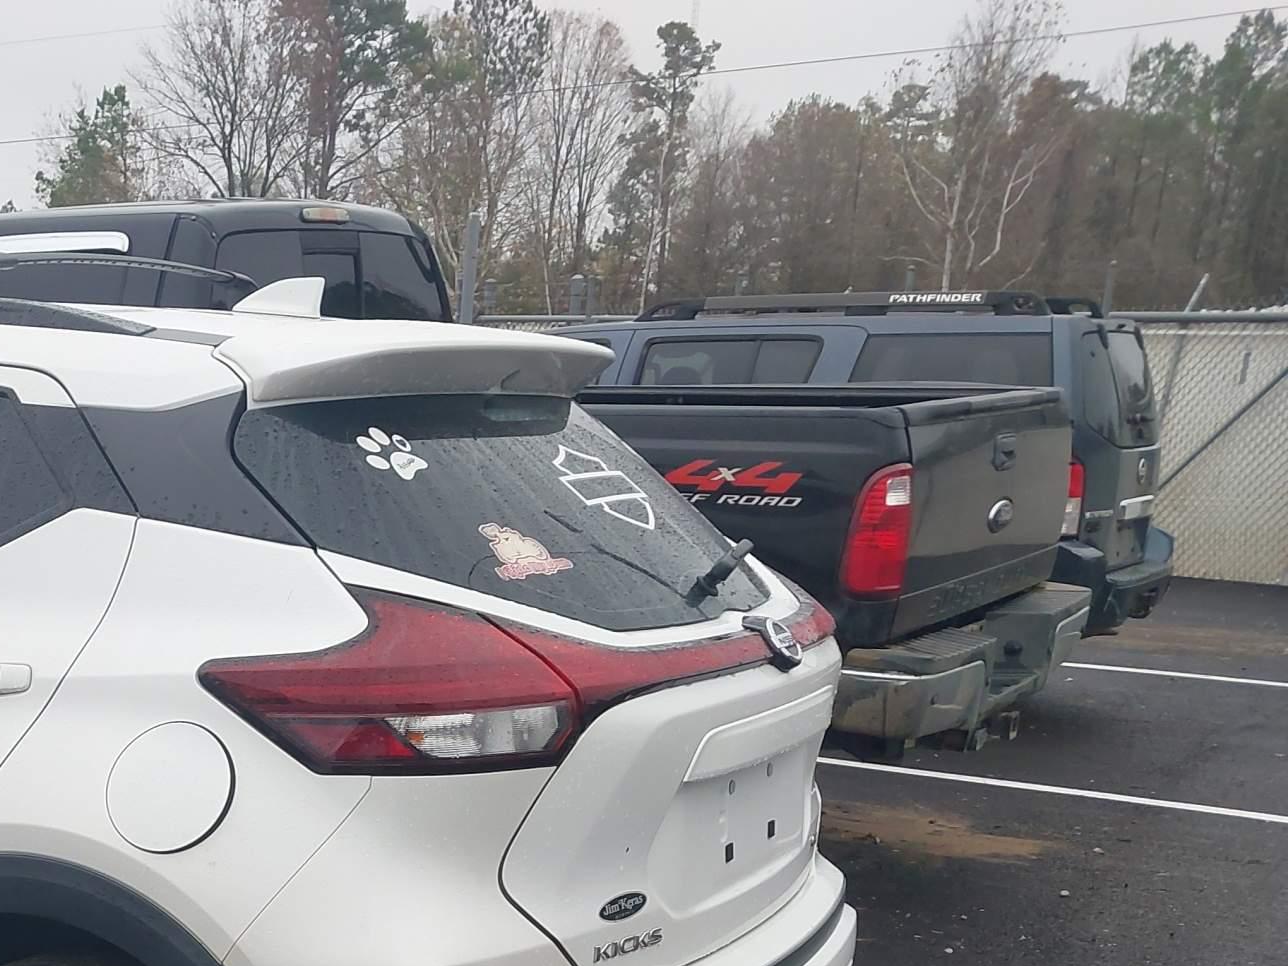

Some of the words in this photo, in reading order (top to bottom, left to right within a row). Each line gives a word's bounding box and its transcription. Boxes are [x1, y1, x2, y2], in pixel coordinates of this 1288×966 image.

[888, 293, 982, 304] PATHFINDER
[716, 494, 803, 508] ROAD
[593, 928, 663, 963] KICKS
